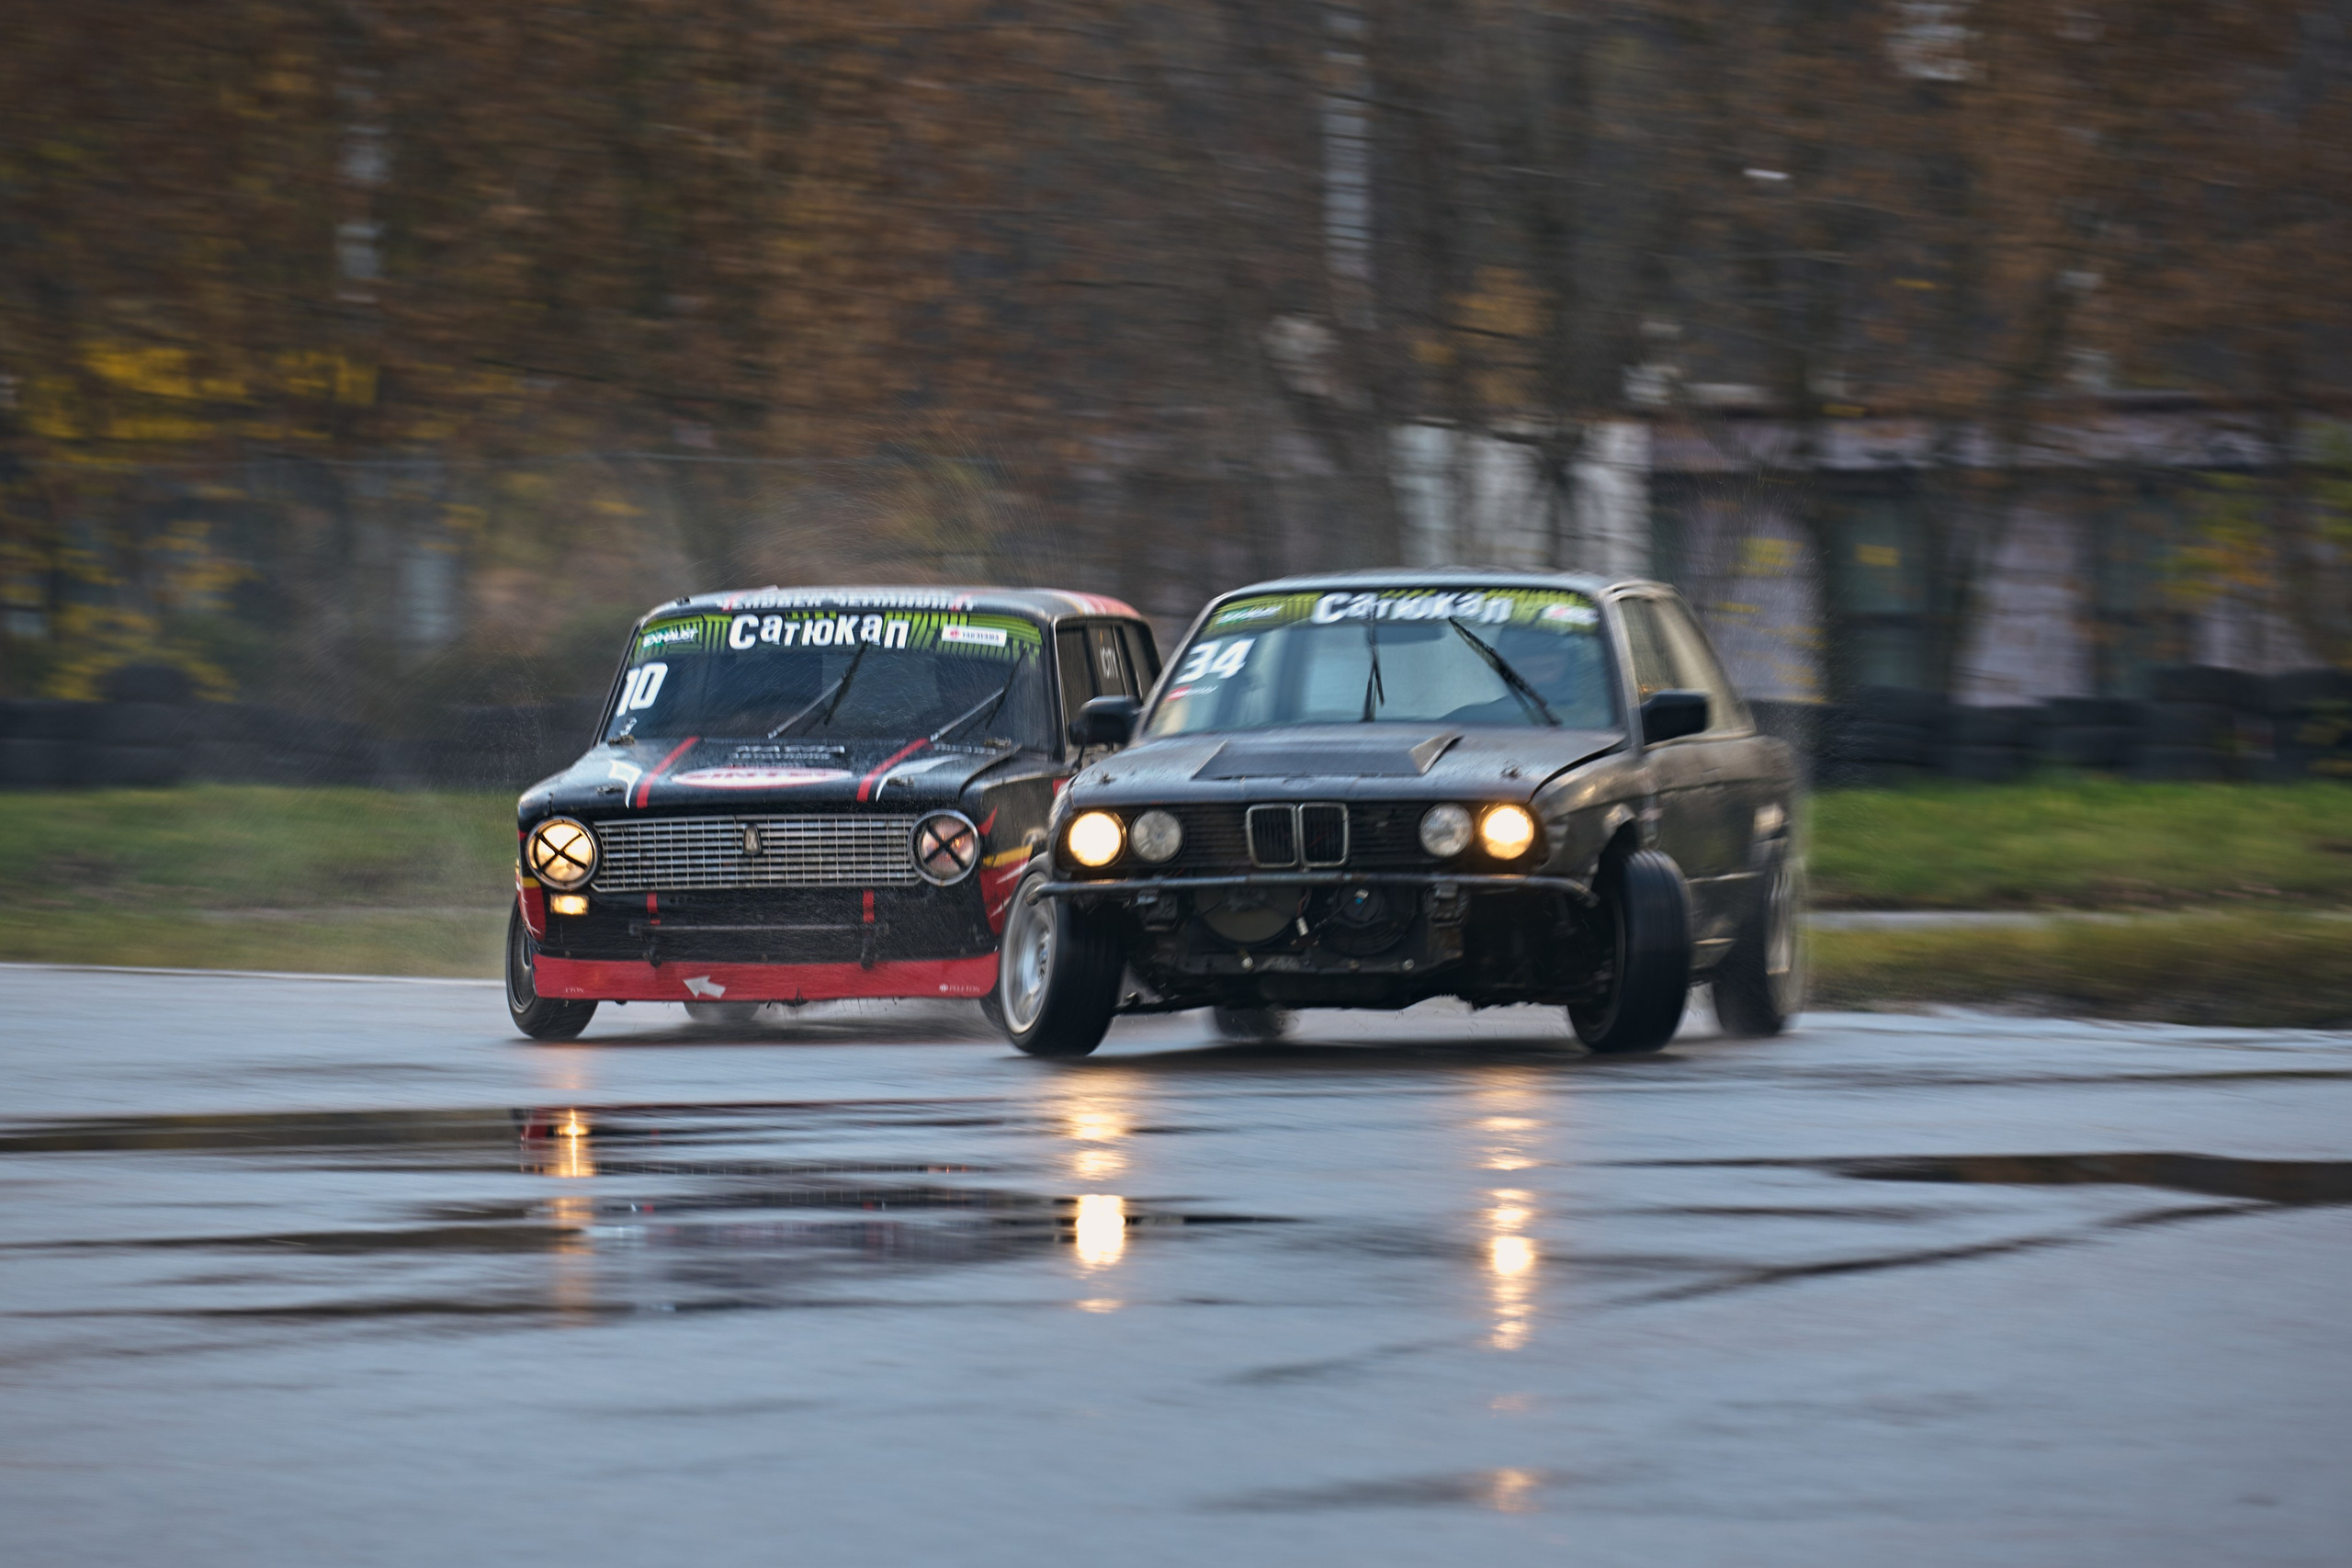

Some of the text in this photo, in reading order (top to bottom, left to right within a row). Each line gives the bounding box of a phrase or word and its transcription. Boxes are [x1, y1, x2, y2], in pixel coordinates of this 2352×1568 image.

[729, 614, 910, 649] Сатюкап
[1174, 637, 1257, 685] 34
[616, 662, 668, 716] 10
